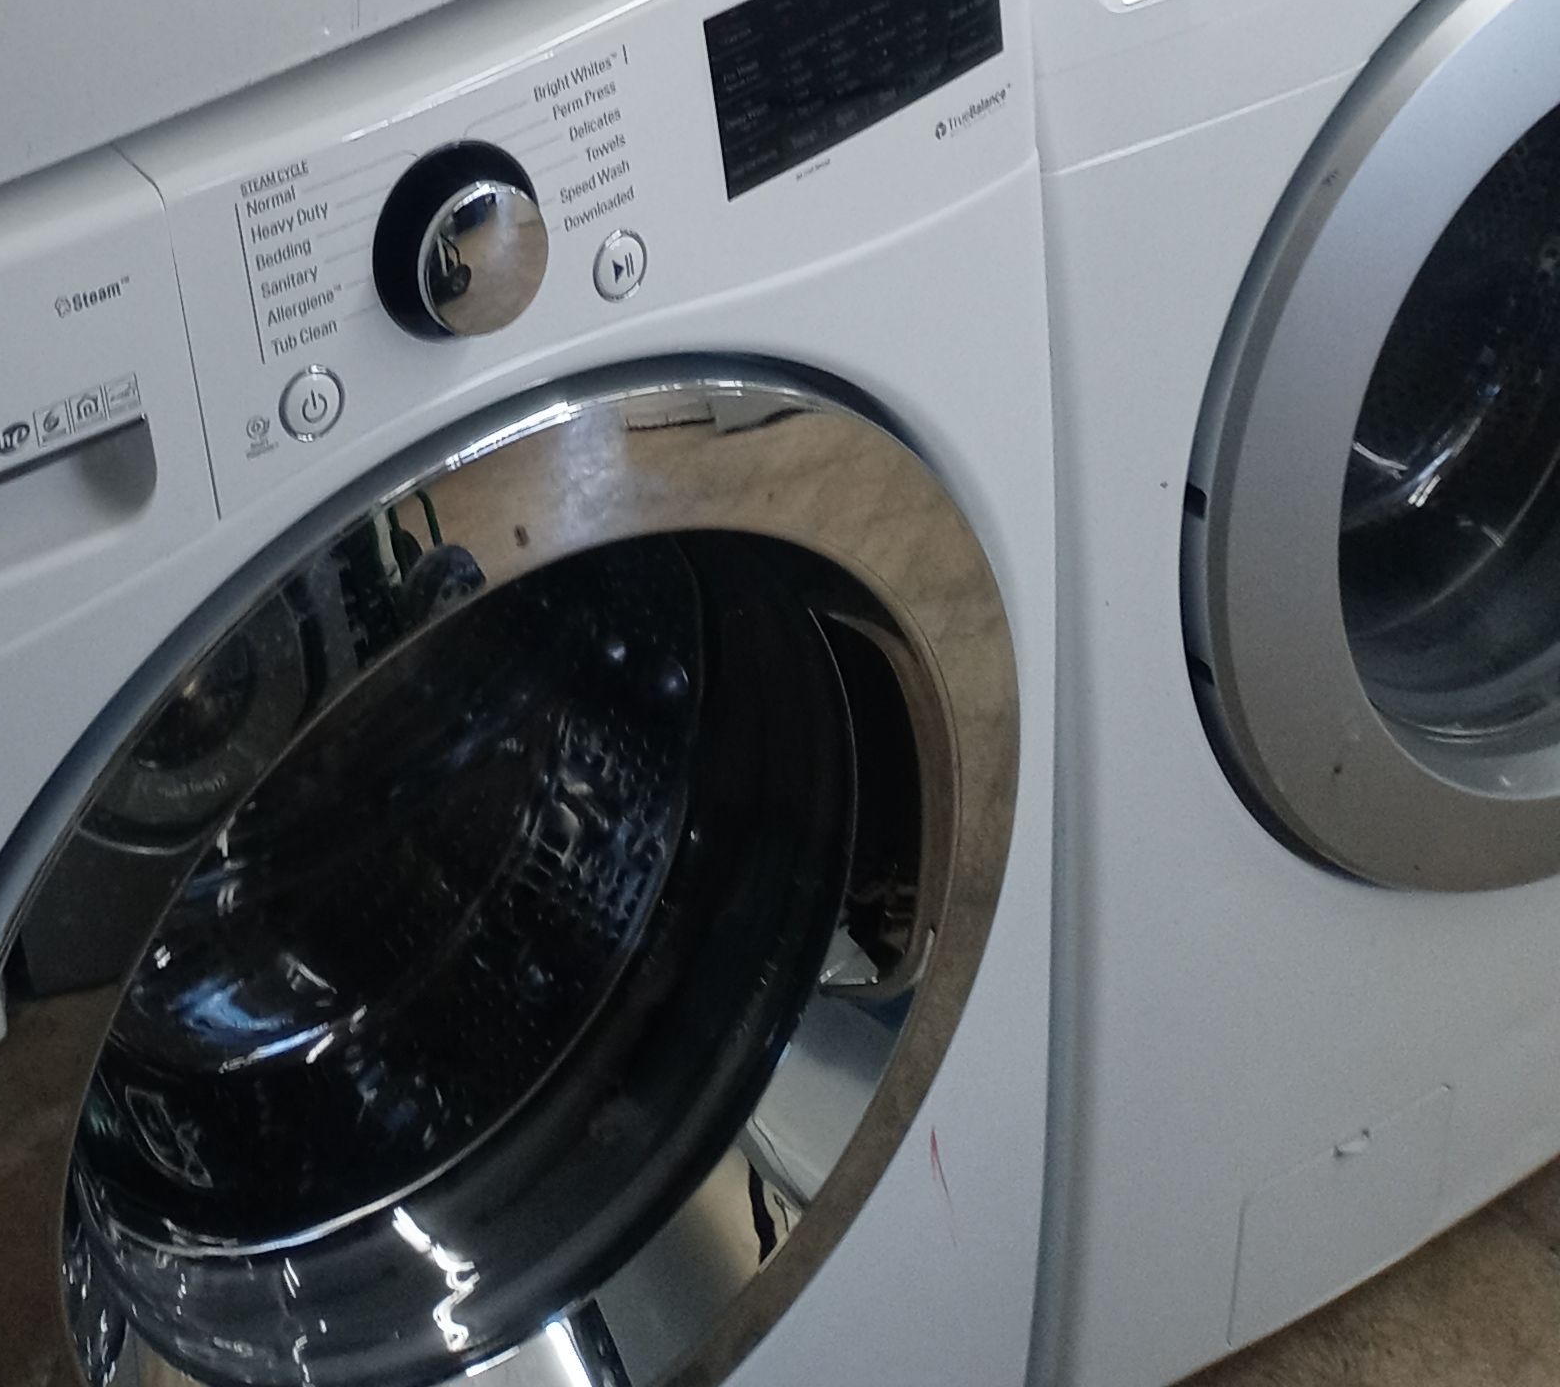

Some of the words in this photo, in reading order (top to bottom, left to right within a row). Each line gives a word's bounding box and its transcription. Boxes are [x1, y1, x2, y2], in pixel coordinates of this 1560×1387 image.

[533, 74, 570, 103] Bright
[552, 98, 584, 121] Perm
[584, 81, 617, 106] Press
[569, 108, 622, 142] Delicates
[585, 133, 627, 162] Towels
[240, 171, 277, 198] STEAM
[278, 159, 309, 184] CYCLE
[560, 176, 597, 204] Speed
[597, 159, 630, 186] Wash
[246, 184, 297, 218] Normal
[563, 184, 635, 233] Downloaded
[250, 216, 294, 244] Heavy
[296, 202, 328, 226] Duty
[255, 238, 312, 272] Bedding
[261, 265, 318, 299] Sanitary
[271, 335, 297, 356] Tub
[299, 320, 338, 346] Clean
